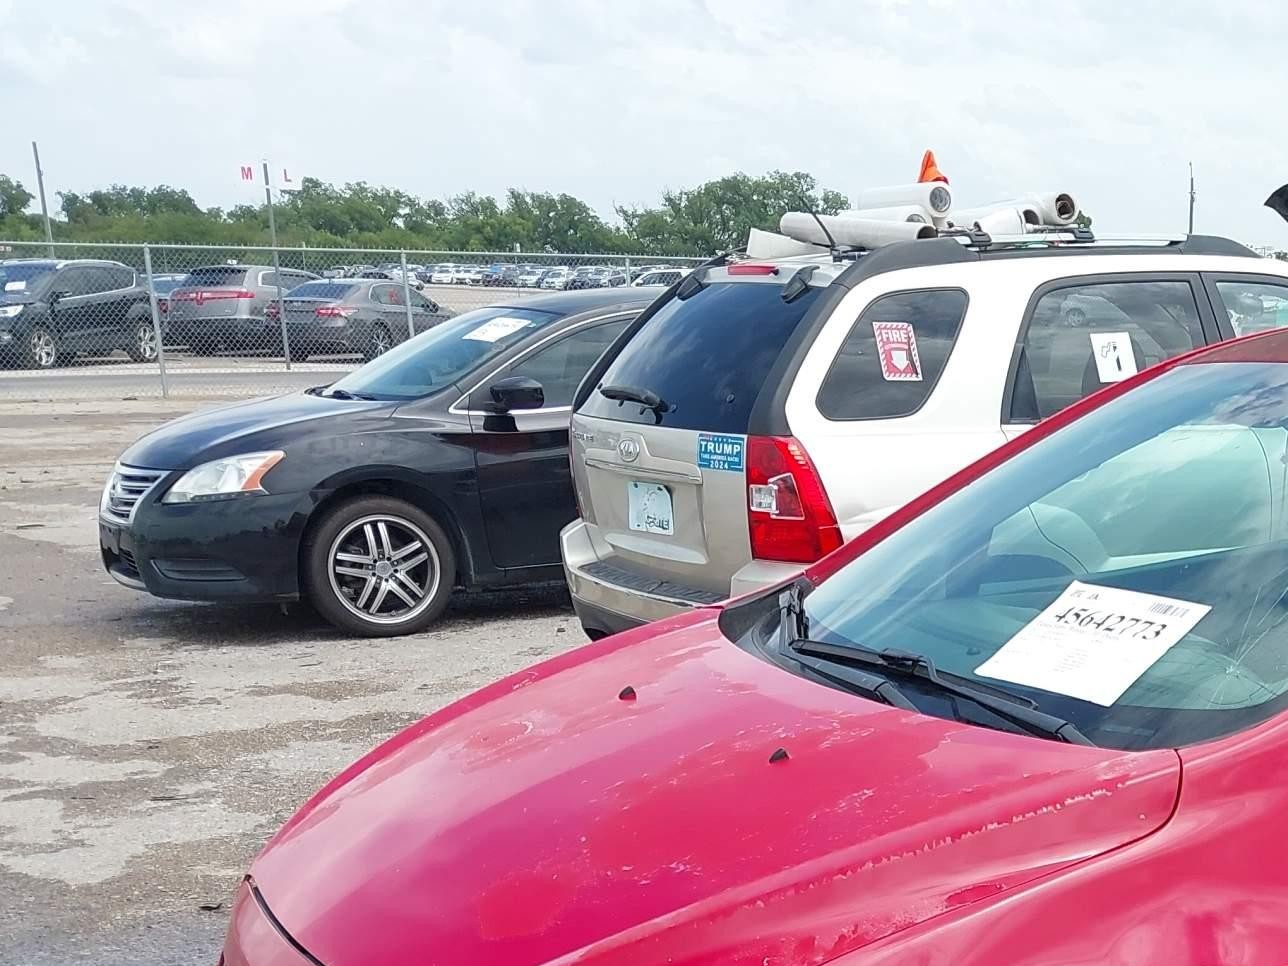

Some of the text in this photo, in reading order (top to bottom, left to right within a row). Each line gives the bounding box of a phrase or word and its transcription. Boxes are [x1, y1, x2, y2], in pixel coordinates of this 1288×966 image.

[240, 166, 253, 181] M
[283, 168, 292, 182] L
[881, 329, 908, 343] FIRE
[700, 440, 741, 456] TRUMP
[710, 460, 729, 470] 2024
[1054, 606, 1168, 640] 45642773
